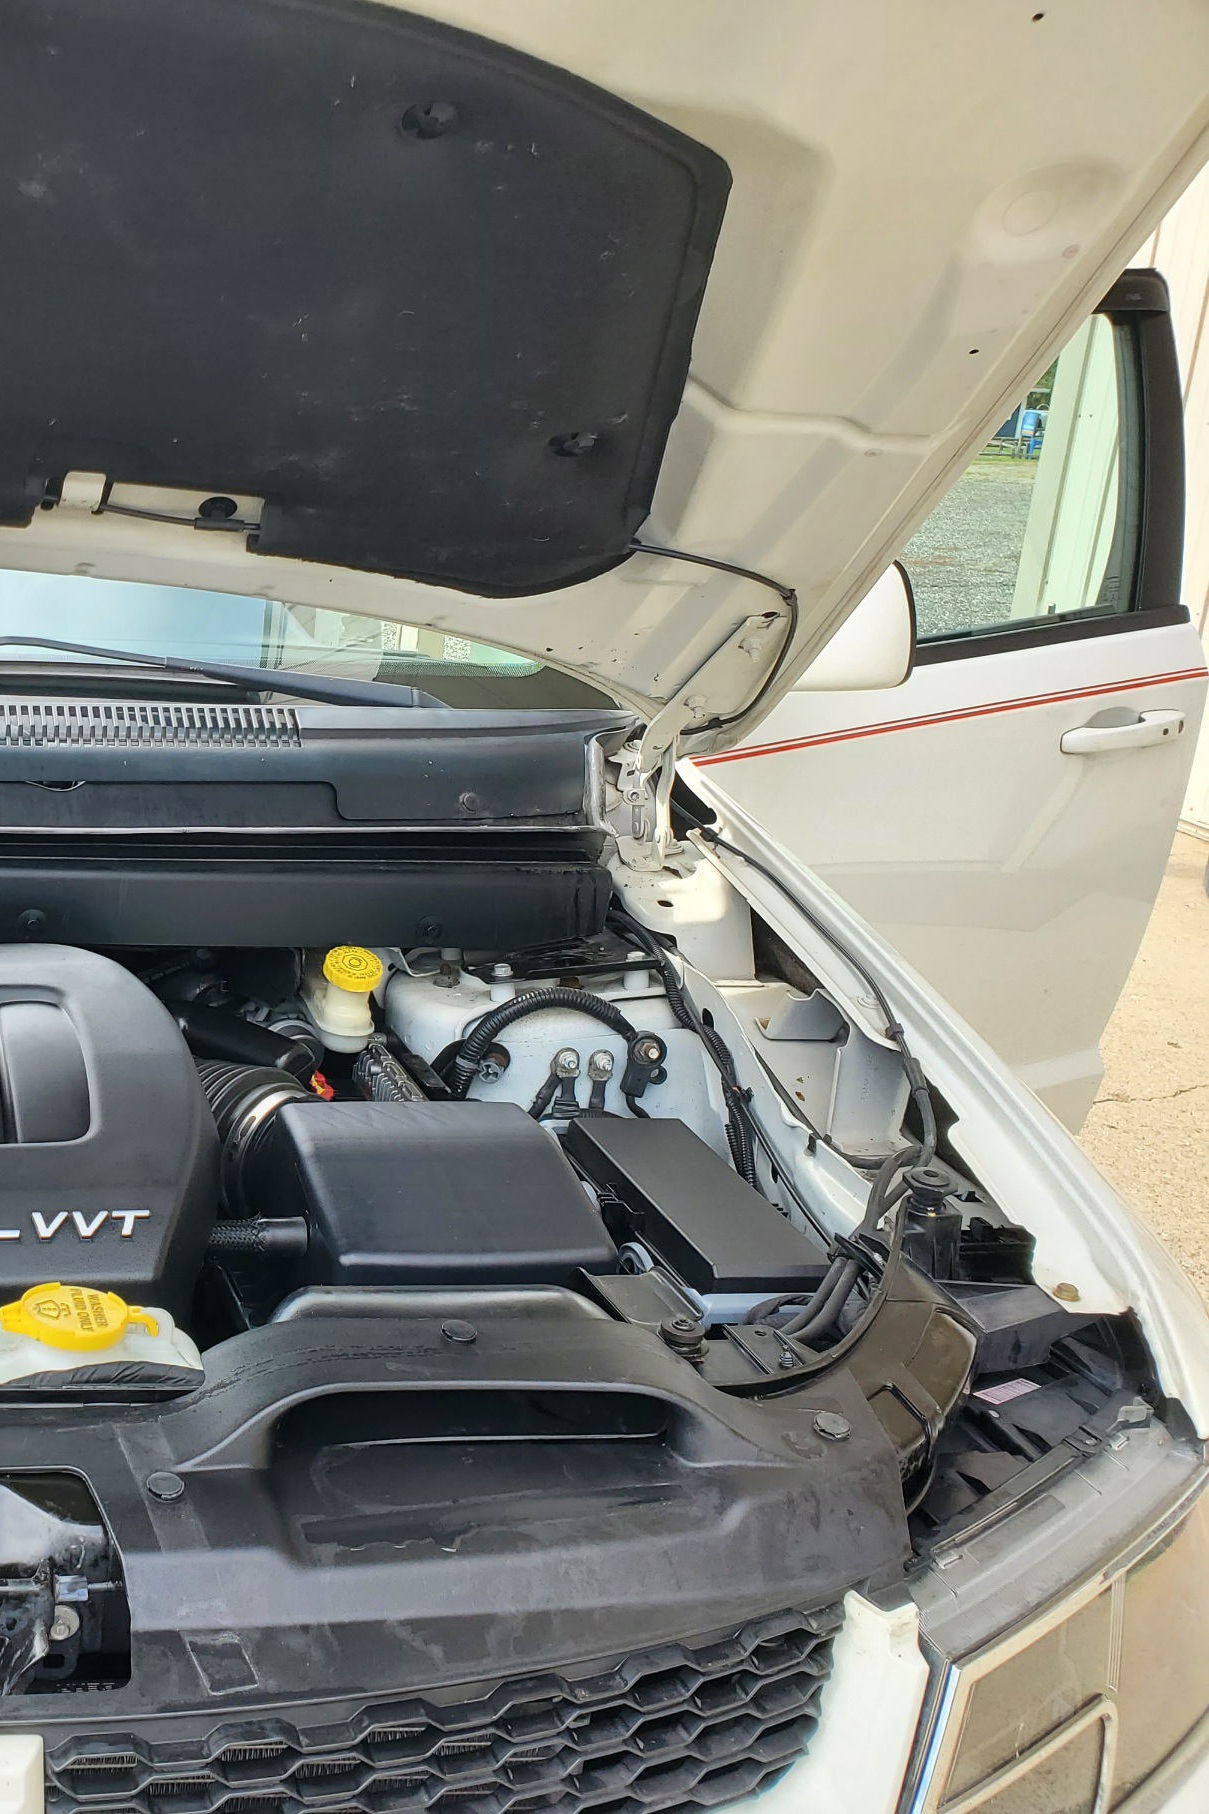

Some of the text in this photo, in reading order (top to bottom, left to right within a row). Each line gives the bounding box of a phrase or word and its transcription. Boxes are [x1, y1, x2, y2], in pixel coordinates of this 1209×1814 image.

[31, 1209, 151, 1241] VVT
[70, 1288, 95, 1333] FLUID ONLY
[87, 1293, 109, 1328] WASHER
